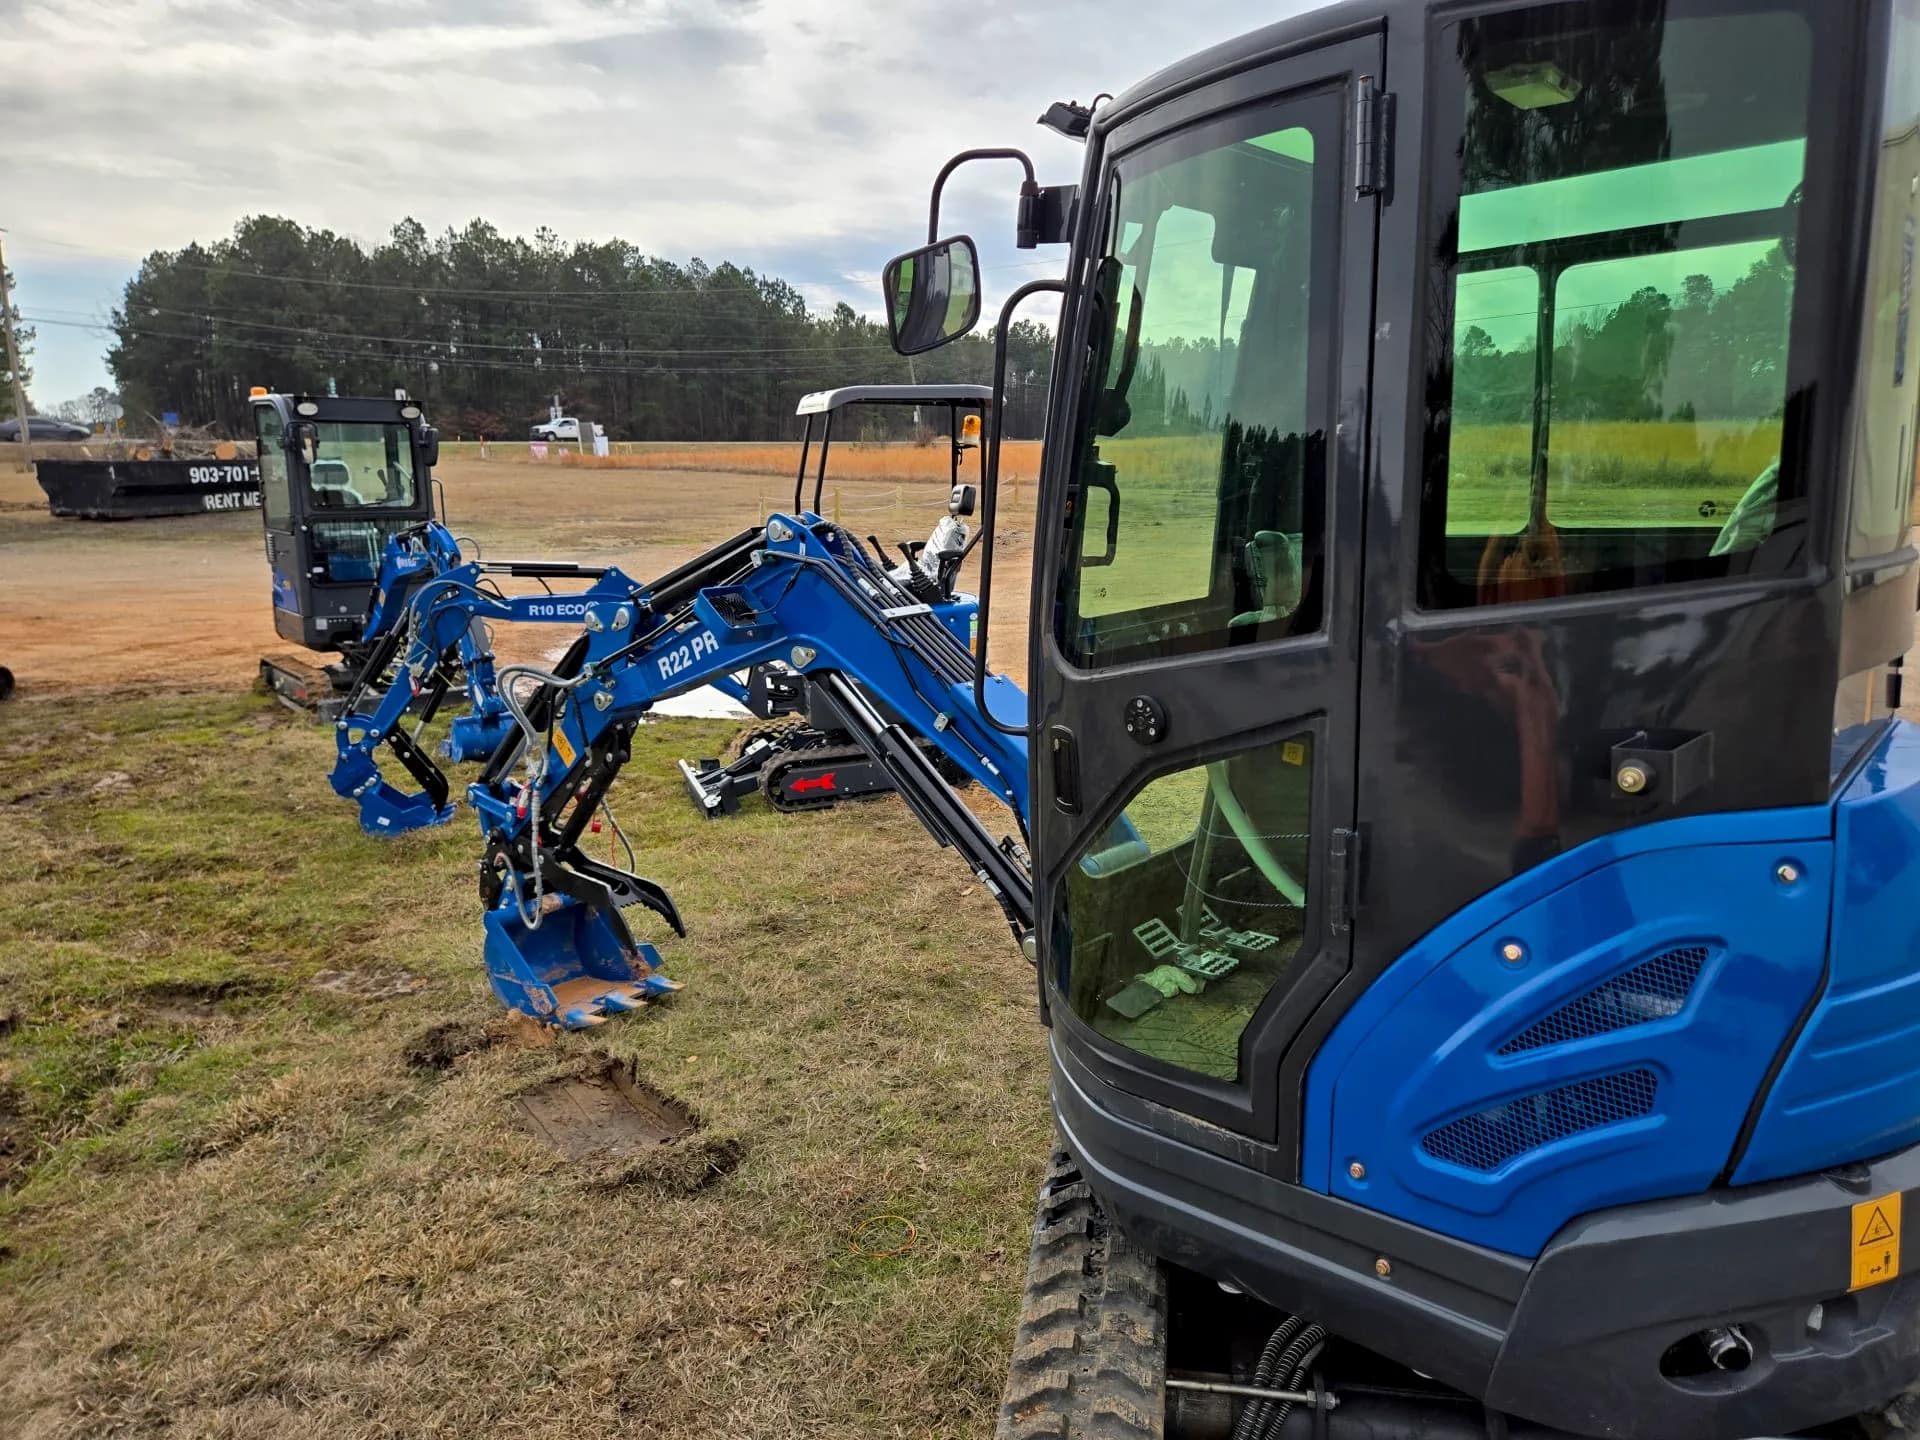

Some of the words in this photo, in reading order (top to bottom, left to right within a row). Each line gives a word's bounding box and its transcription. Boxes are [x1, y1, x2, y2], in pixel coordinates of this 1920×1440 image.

[204, 493, 240, 510] RENT
[243, 491, 262, 507] ME
[528, 605, 554, 616] R10
[556, 604, 585, 616] ECO
[657, 645, 693, 681] R22
[691, 629, 719, 661] PR
